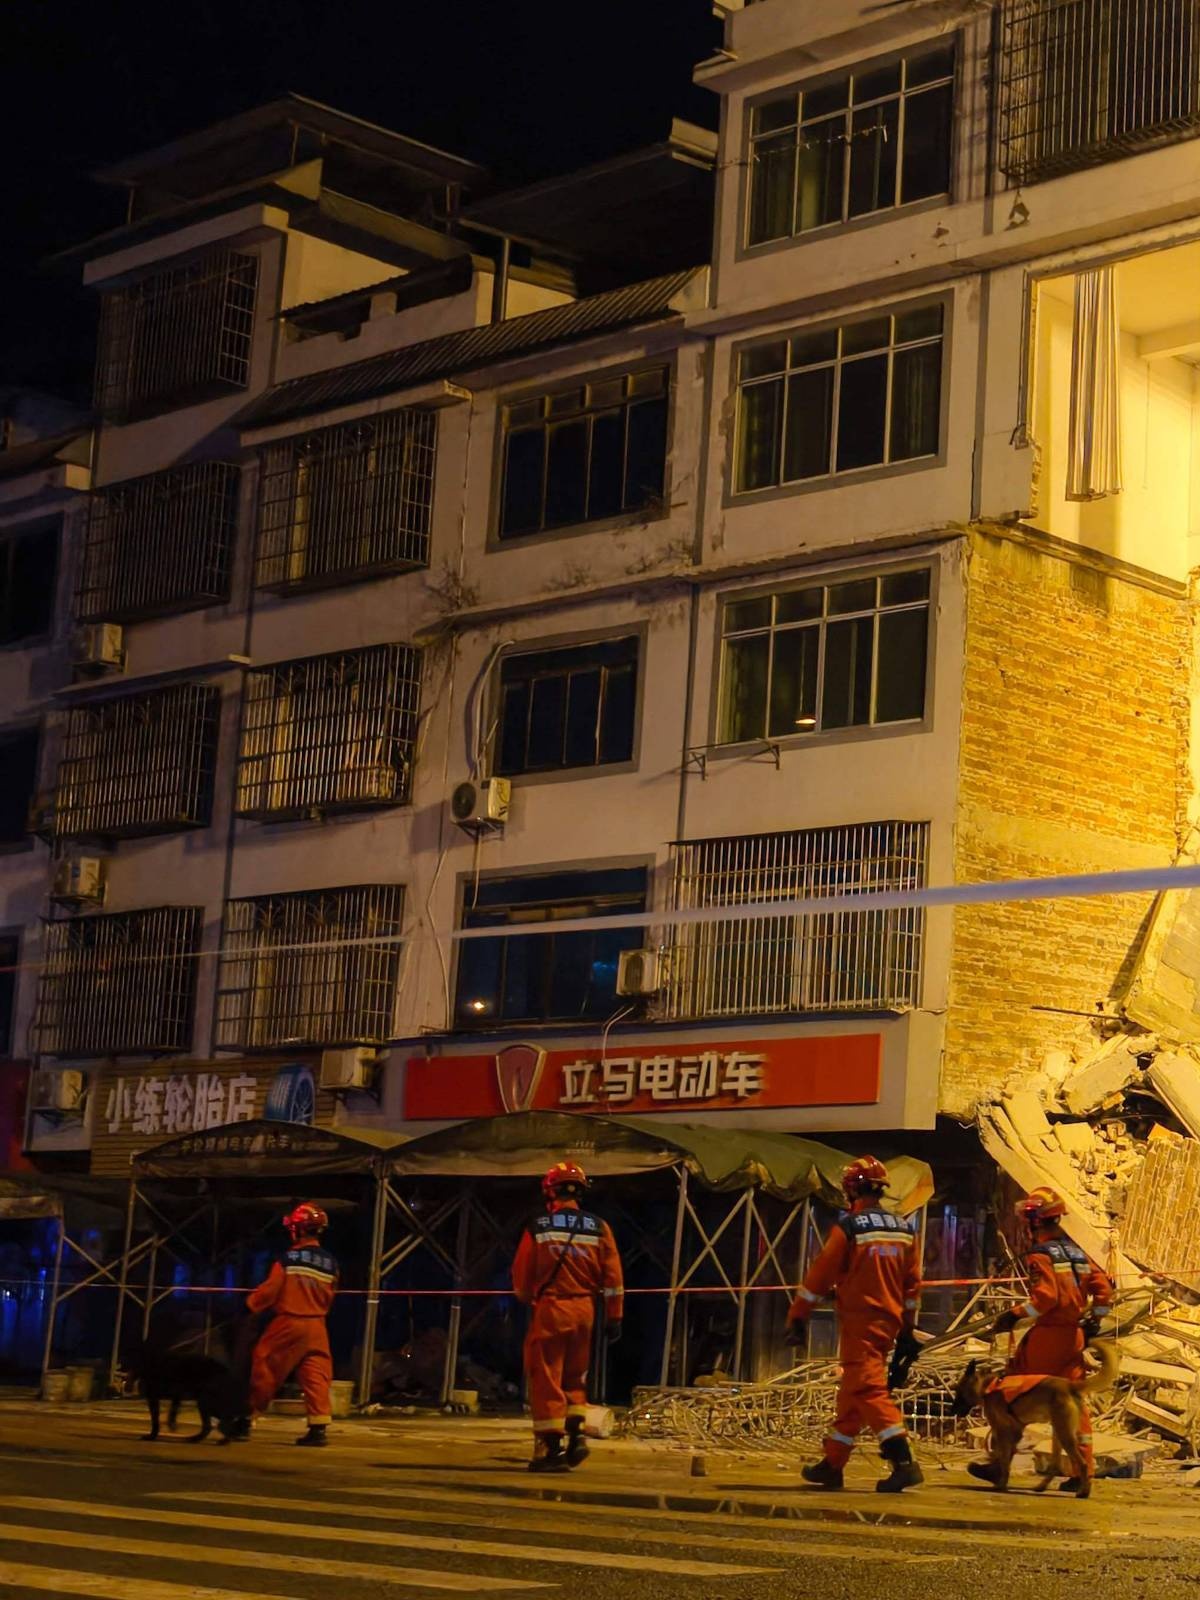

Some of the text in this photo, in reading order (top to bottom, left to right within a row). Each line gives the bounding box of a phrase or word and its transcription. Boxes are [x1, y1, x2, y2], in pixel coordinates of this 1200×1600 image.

[562, 1051, 766, 1105] 立马电动车
